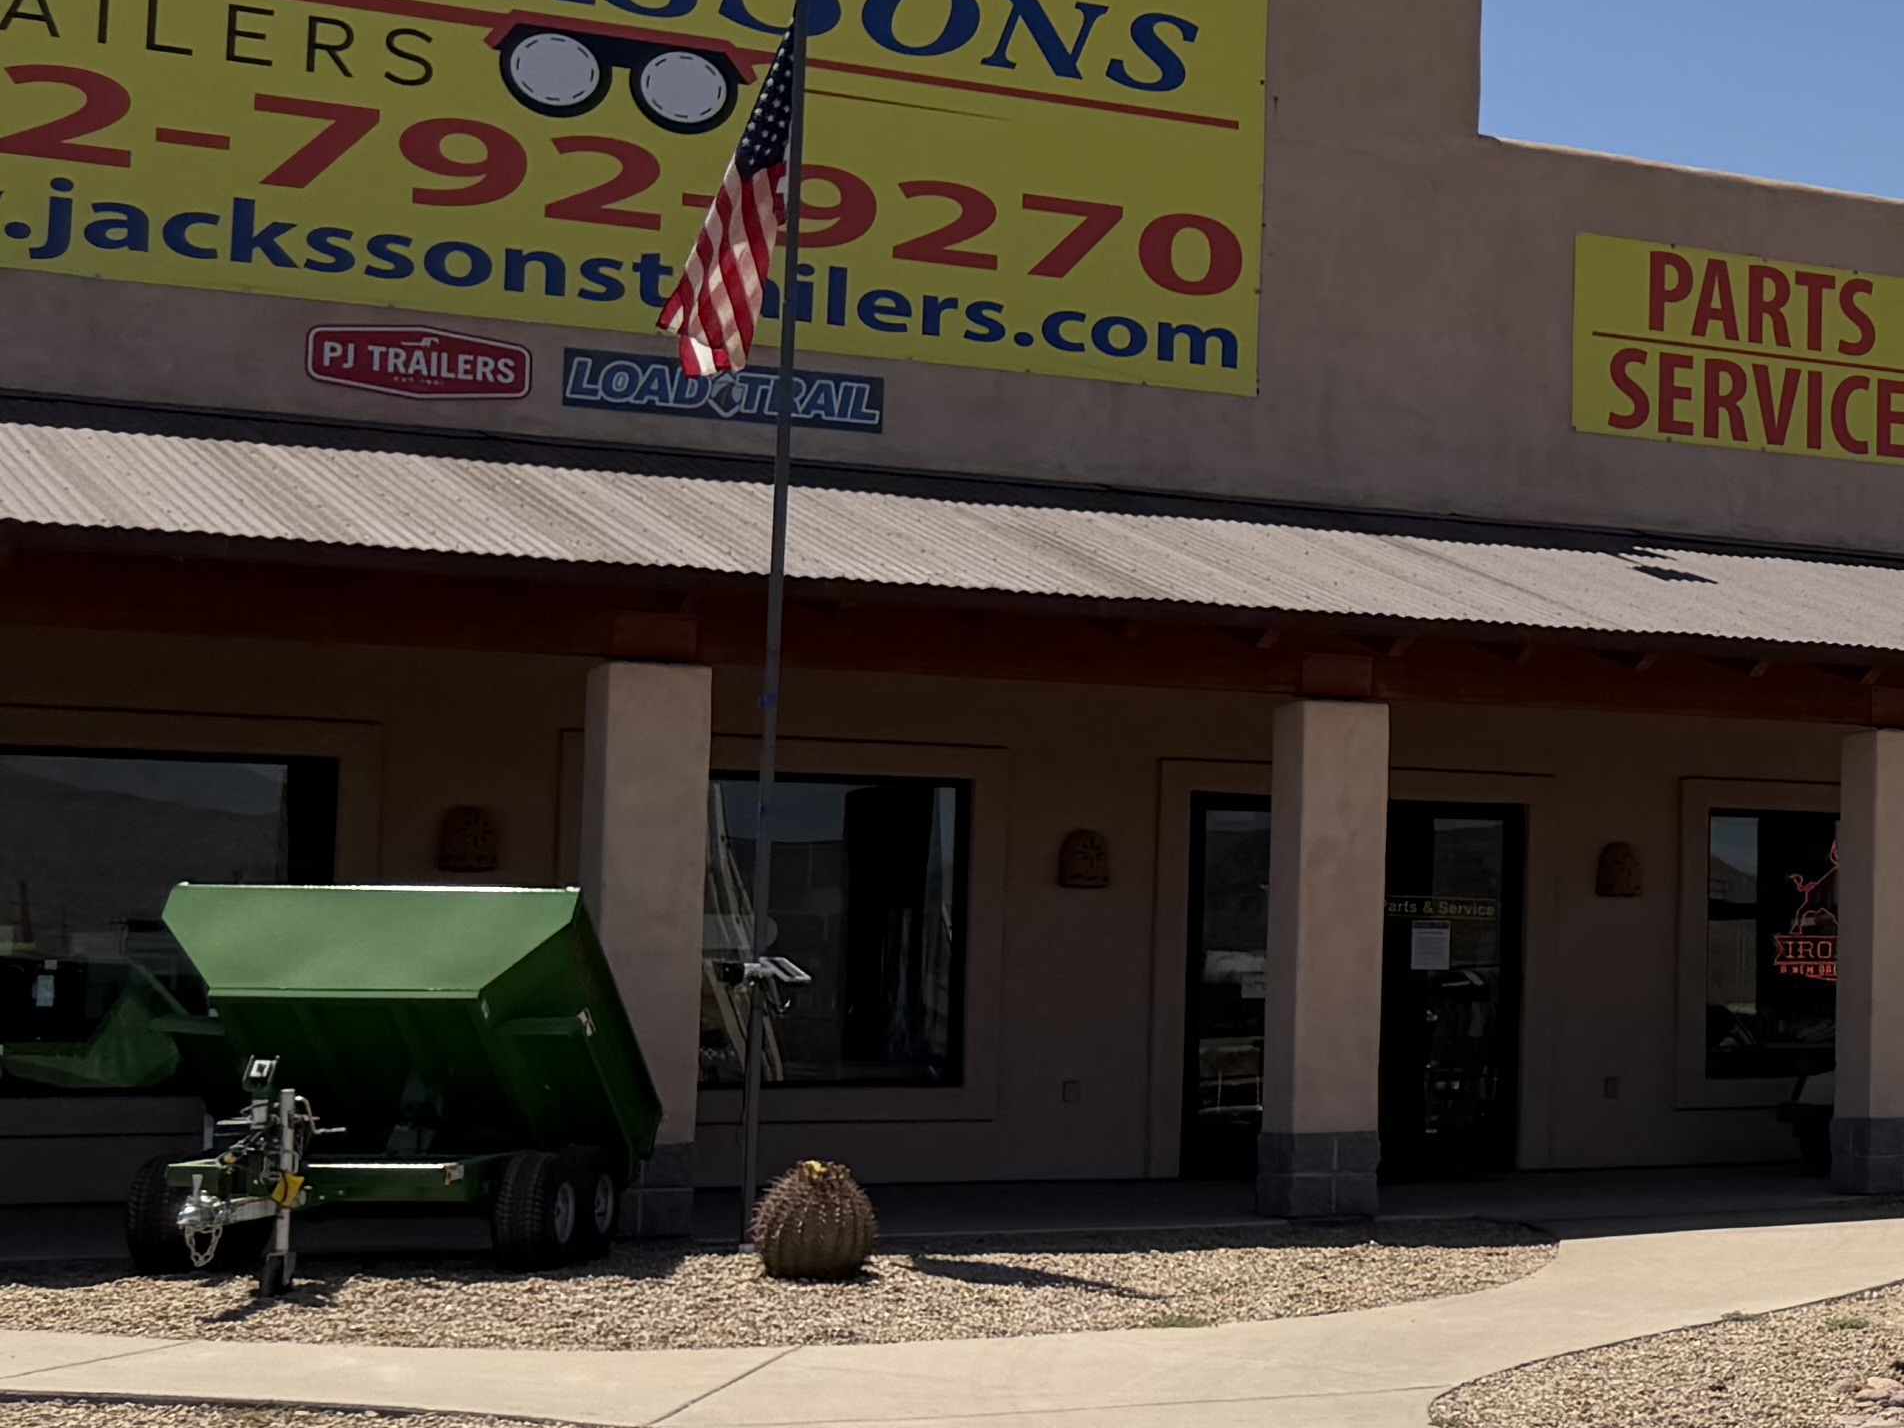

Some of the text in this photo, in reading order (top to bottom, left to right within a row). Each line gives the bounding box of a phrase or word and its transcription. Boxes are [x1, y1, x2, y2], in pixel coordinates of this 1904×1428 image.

[1649, 250, 1877, 356] PARTS
[322, 340, 516, 384] PJ TRAILERS
[566, 356, 880, 425] LOAD TRAIL
[1384, 899, 1496, 916] arts & Service
[1783, 940, 1837, 959] IRO
